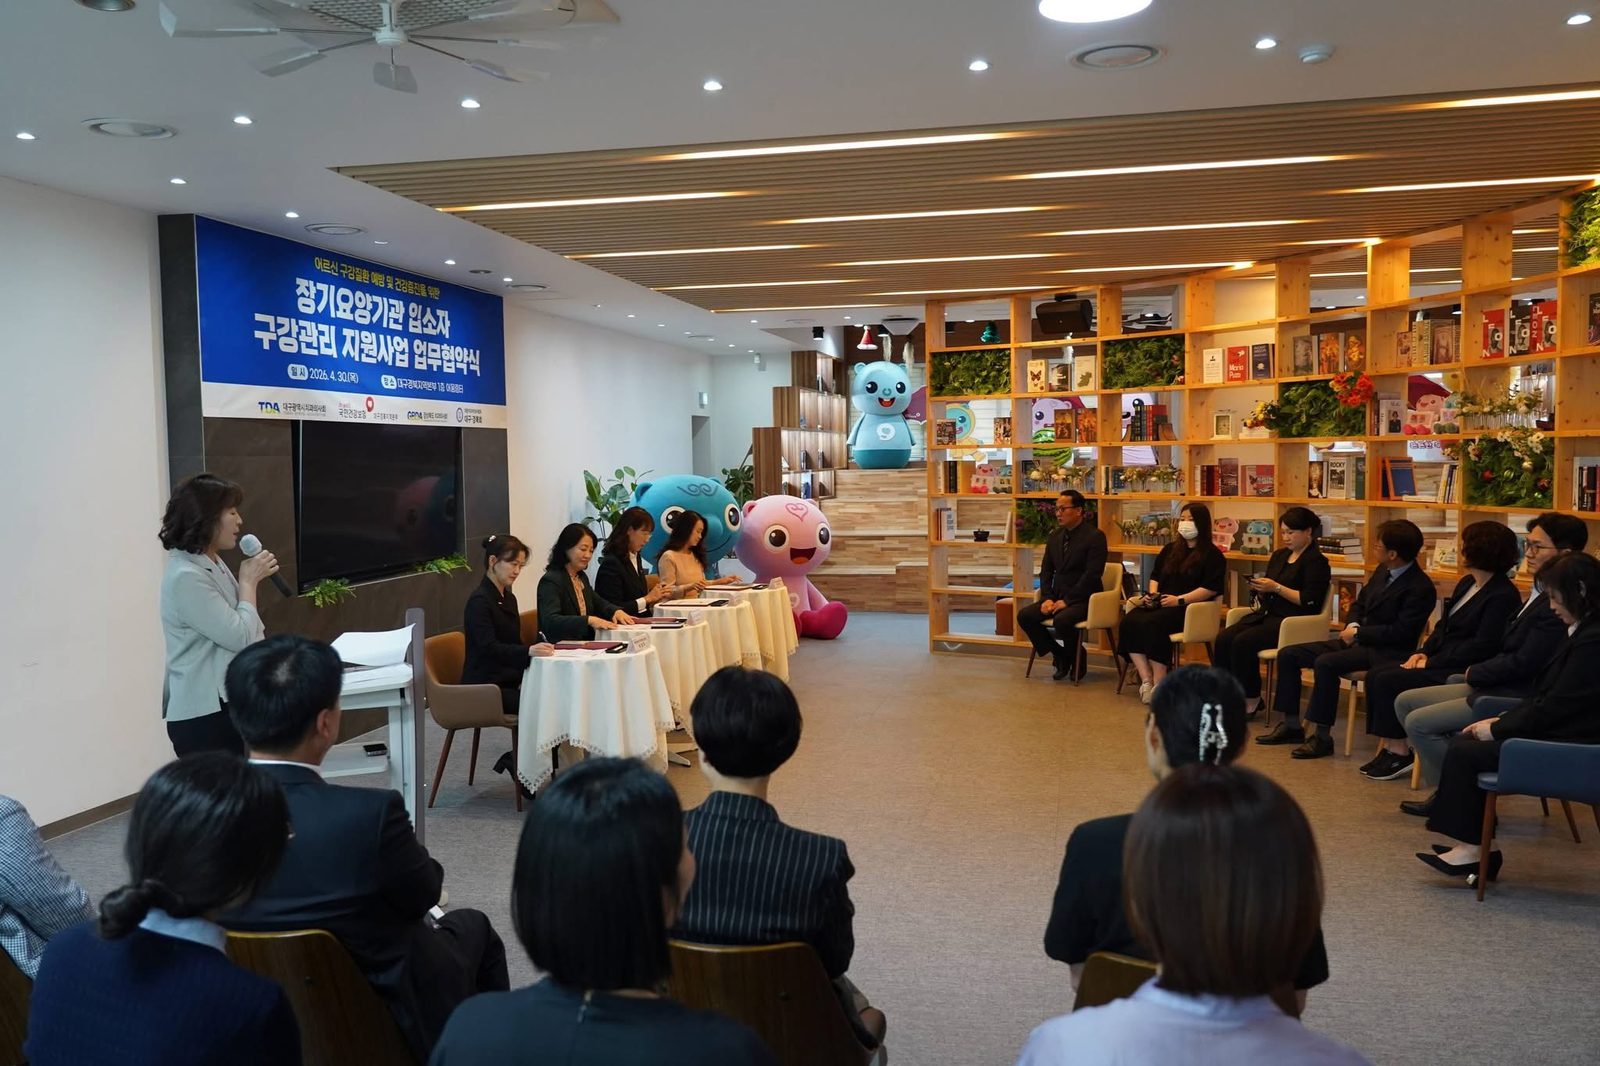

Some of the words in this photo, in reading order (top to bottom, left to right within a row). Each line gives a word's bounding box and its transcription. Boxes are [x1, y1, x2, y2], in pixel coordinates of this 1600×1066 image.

[314, 257, 338, 277] 어르신
[340, 263, 369, 284] 구강질환
[387, 275, 394, 289] 및
[427, 286, 440, 300] 위한
[295, 277, 405, 331] 장기요양기관
[408, 301, 451, 339] 입소자
[254, 313, 338, 358] 구강관리
[342, 327, 409, 368] 지원사업
[413, 338, 481, 377] 업무협약식
[258, 401, 281, 414] TDA
[339, 408, 367, 419] 국민건강보험
